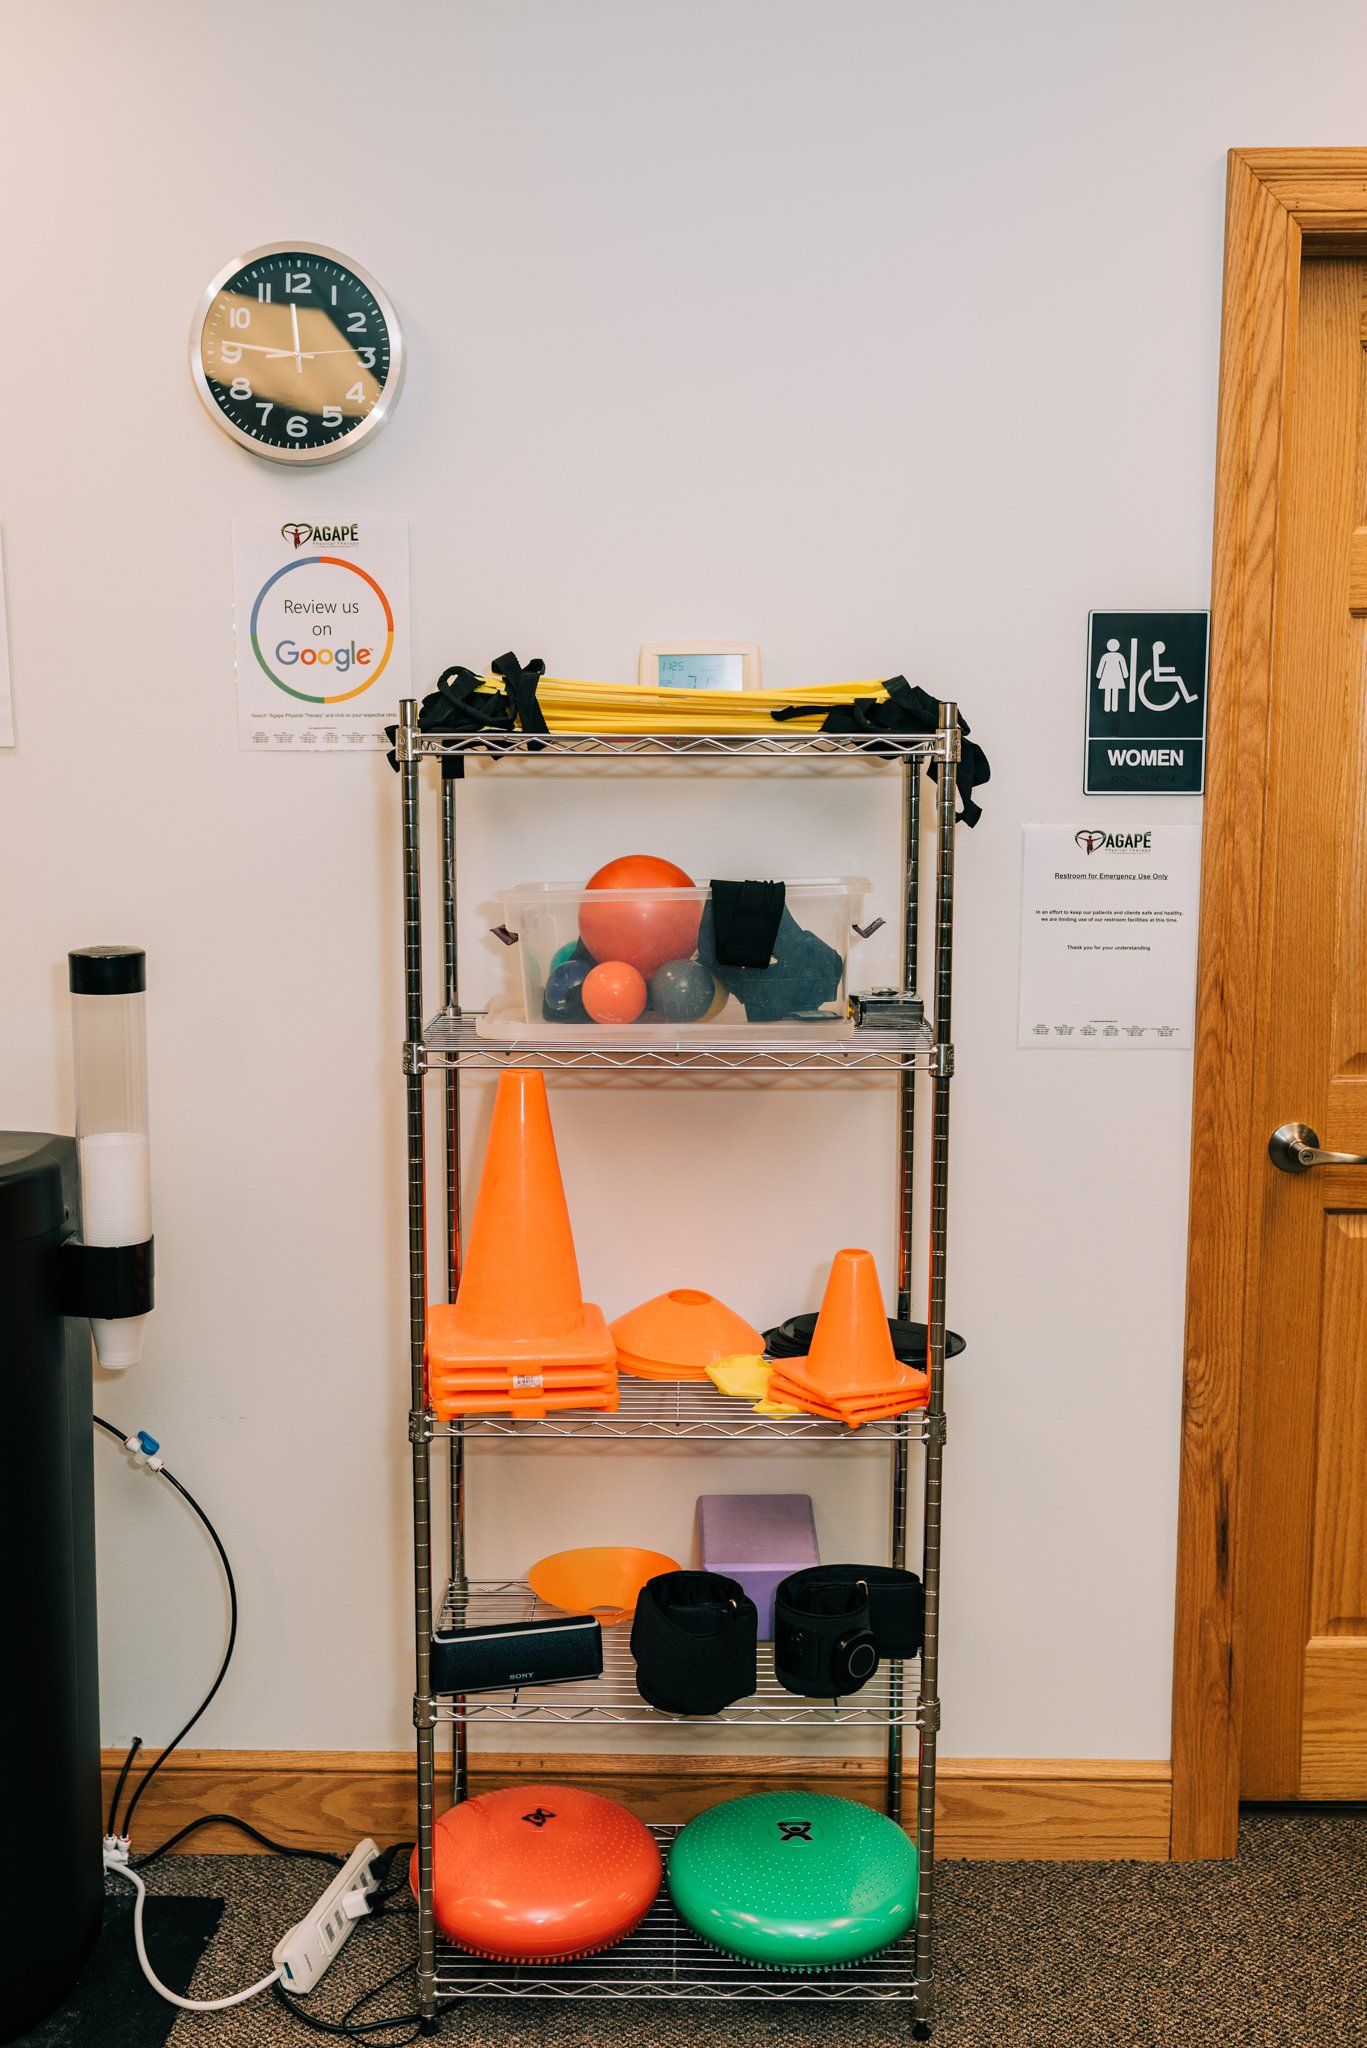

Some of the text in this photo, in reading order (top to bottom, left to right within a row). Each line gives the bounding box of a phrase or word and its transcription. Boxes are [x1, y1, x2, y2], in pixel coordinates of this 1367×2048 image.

[258, 283, 272, 303] 11
[285, 273, 312, 294] 12
[331, 285, 337, 305] 1
[229, 307, 251, 329] 10
[347, 312, 367, 333] 2
[220, 343, 242, 364] 9
[356, 347, 376, 368] 3
[229, 377, 252, 400] 8
[345, 382, 366, 404] 4
[255, 403, 274, 426] 7
[321, 406, 343, 428] 5
[286, 416, 309, 437] 6
[313, 523, 359, 541] AGAPÉ
[284, 600, 360, 614] Review us
[312, 624, 332, 636] on
[1107, 750, 1184, 766] WOMEN
[1106, 831, 1151, 848] AGAPÉ
[1054, 872, 1087, 880] Restroom
[1099, 873, 1137, 881] Emergency
